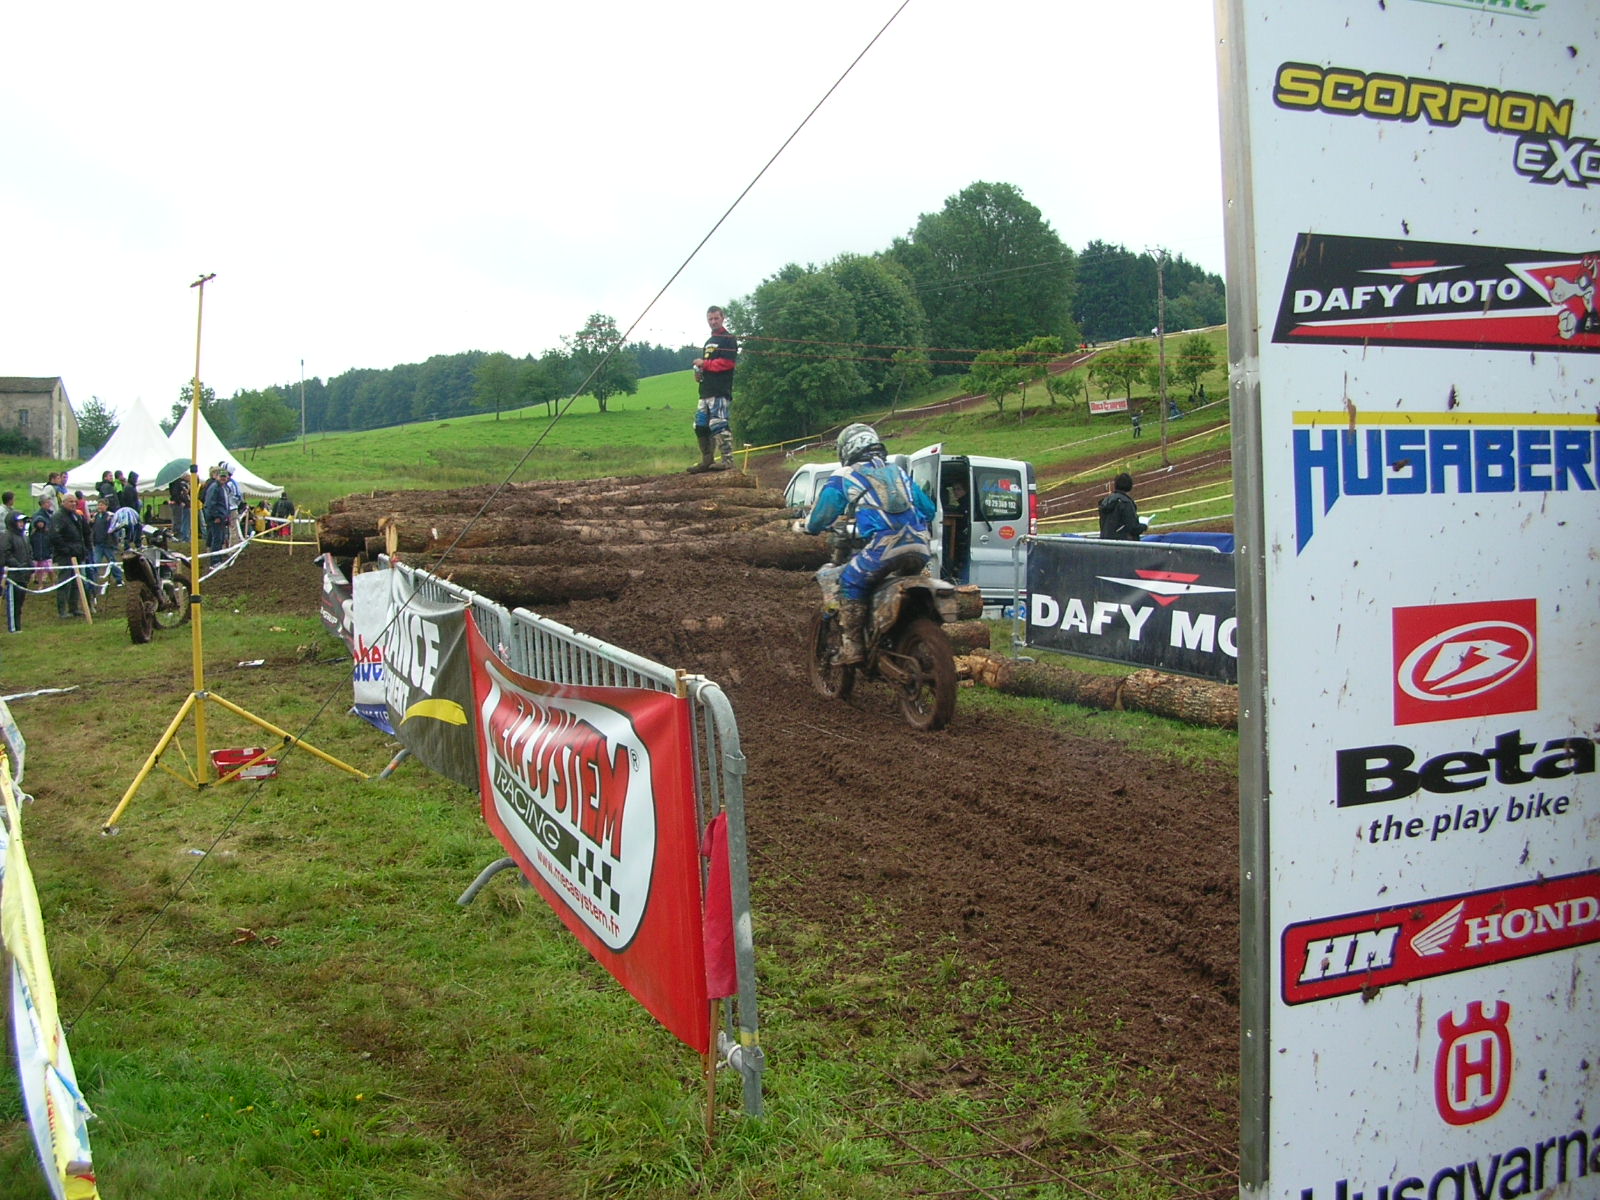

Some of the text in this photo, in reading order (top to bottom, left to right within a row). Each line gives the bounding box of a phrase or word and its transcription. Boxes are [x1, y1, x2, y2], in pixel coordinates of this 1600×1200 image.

[1274, 62, 1574, 137] SCORPION
[1293, 278, 1521, 314] DAFY MOTO
[1292, 428, 1600, 557] HUSABER
[1031, 593, 1154, 641] DAFY
[1337, 729, 1595, 808] Beta
[496, 770, 561, 851] RACING
[1369, 792, 1570, 844] the play bike
[536, 847, 620, 938] www.mecasystem.fr
[1299, 896, 1600, 984] HM HOND
